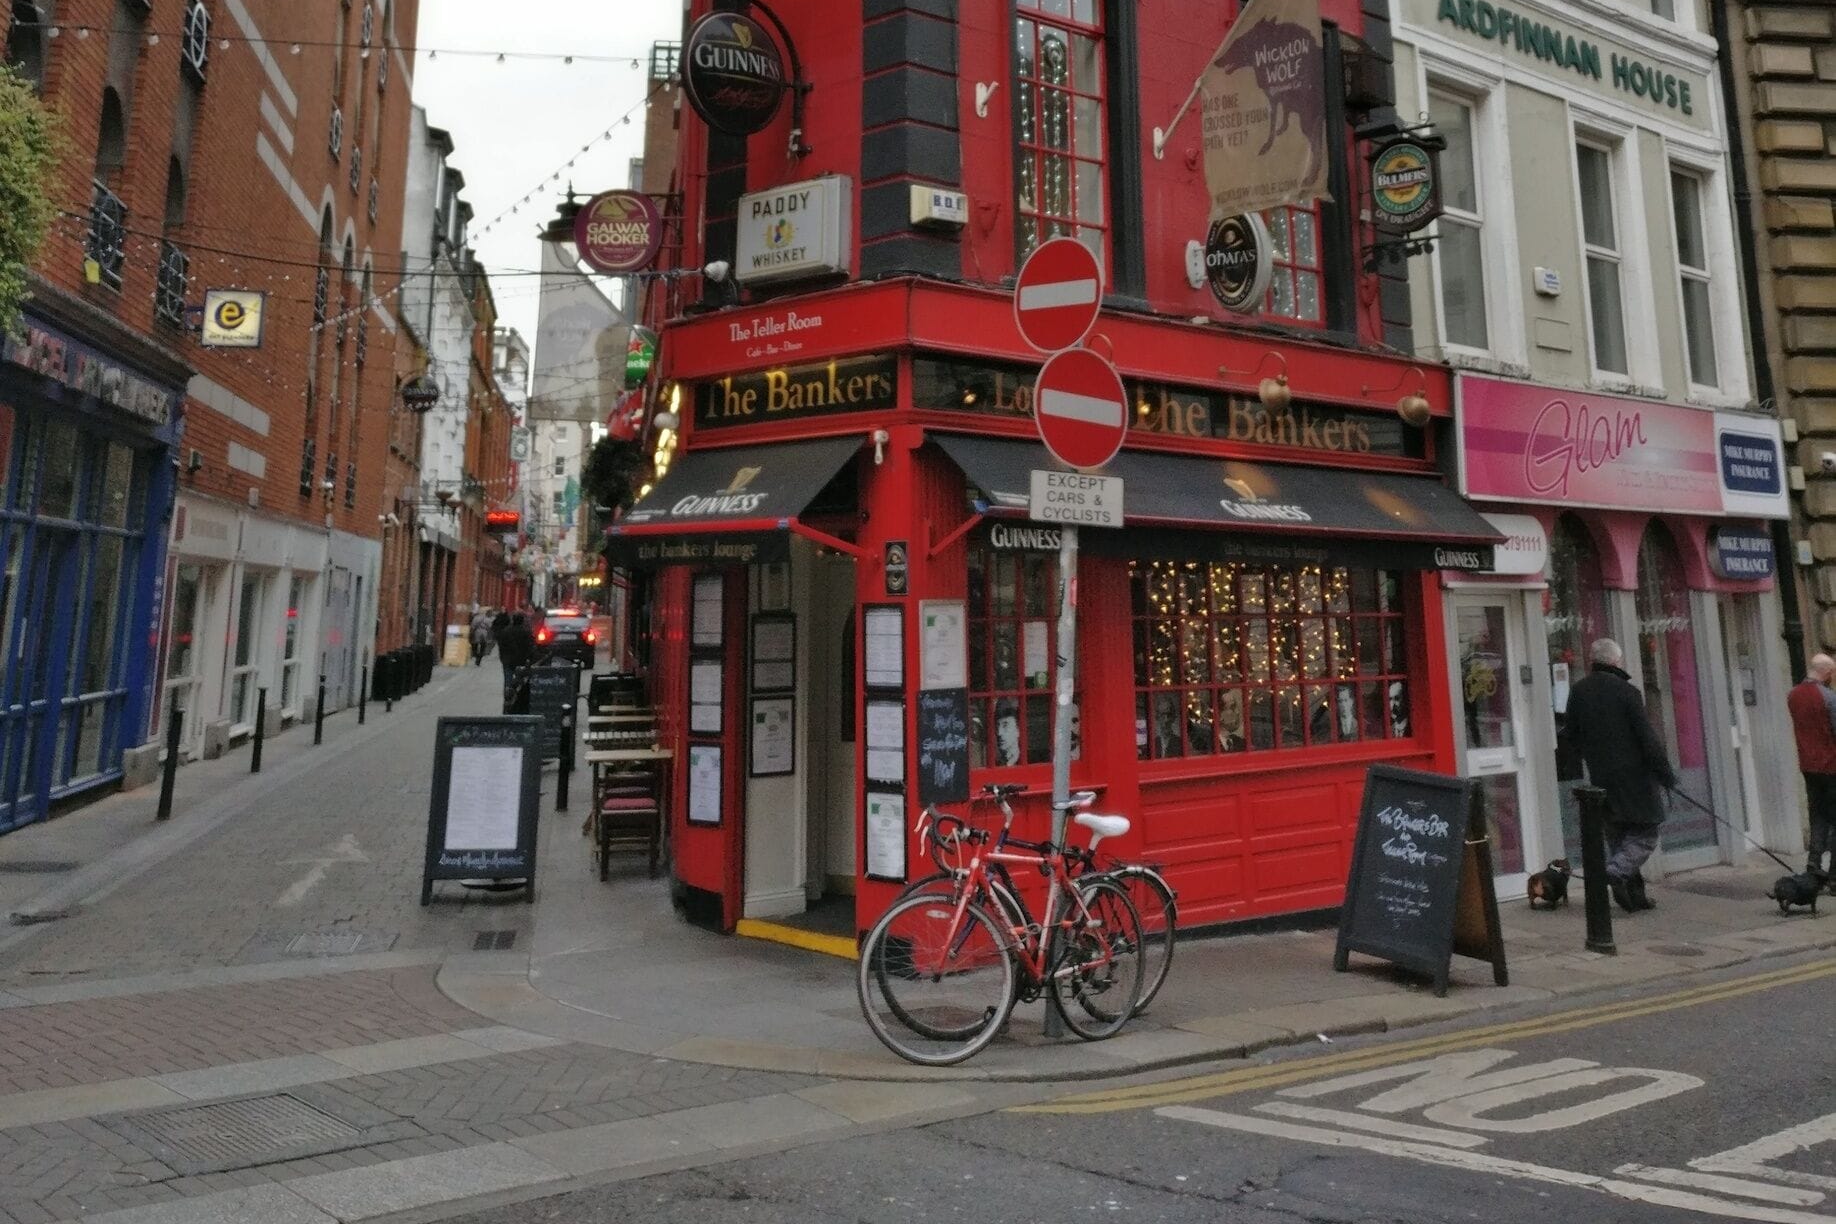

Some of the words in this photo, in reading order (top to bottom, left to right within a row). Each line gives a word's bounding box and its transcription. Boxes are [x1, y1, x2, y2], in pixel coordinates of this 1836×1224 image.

[695, 43, 780, 81] GUINNESS
[1254, 37, 1310, 68] WICKLOW
[1265, 58, 1302, 84] WOLF
[1611, 51, 1693, 116] HOUSE
[1377, 171, 1428, 186] BULMERS
[753, 191, 811, 220] PADDY
[1390, 199, 1434, 224] DRAUGHT
[586, 222, 650, 234] GALWAY
[586, 233, 650, 245] HOOKER
[752, 246, 806, 269] WHISKEY
[729, 323, 752, 342] The
[752, 317, 785, 338] Teller
[787, 311, 822, 331] Room
[705, 376, 757, 418] The
[765, 358, 892, 413] Bankers
[1134, 384, 1208, 437] The
[1228, 396, 1371, 452] Bankers
[1524, 398, 1648, 497] Glam
[1745, 447, 1774, 463] MURPHY
[1047, 474, 1106, 491] EXCEPT
[1730, 463, 1771, 480] INSURANCE
[671, 492, 768, 515] GUINNESS
[1046, 490, 1086, 505] CARS
[1094, 495, 1103, 506] &
[1042, 506, 1112, 523] CYCLISTS
[1220, 499, 1313, 521] GUINNESS
[990, 522, 1060, 549] GUINNESS
[1740, 537, 1771, 553] MURPHY
[1434, 547, 1480, 569] GUINNESS
[1726, 557, 1769, 573] INSURANCE
